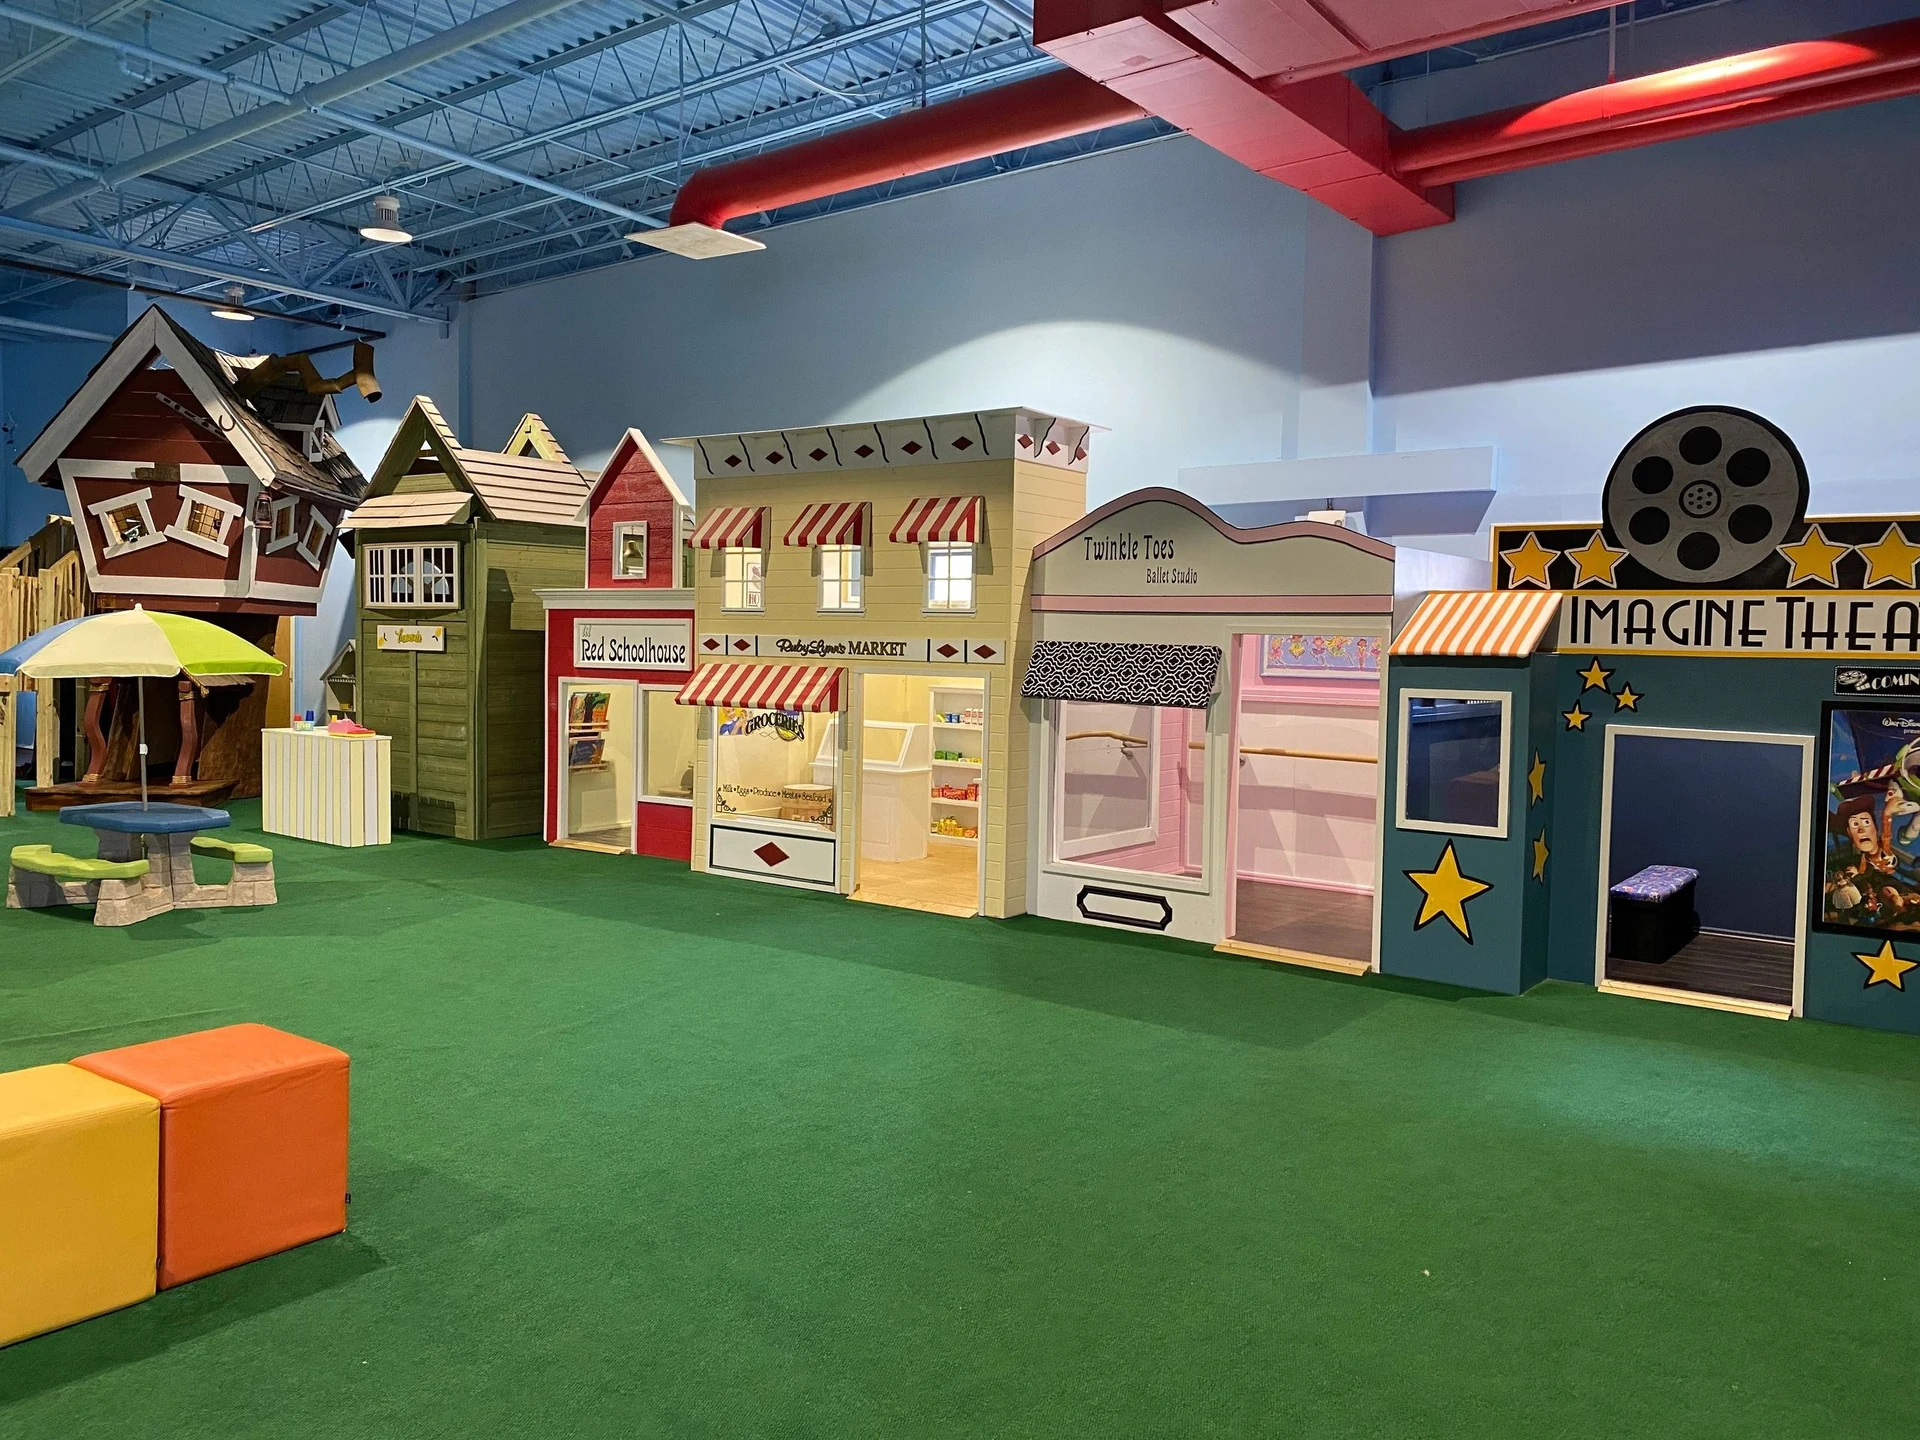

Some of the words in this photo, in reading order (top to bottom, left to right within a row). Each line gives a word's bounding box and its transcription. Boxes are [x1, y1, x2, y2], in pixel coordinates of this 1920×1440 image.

[1084, 532, 1139, 561] Twinkle
[1143, 535, 1175, 560] Toes
[1146, 566, 1169, 584] Ballet
[1171, 567, 1198, 584] Studio
[748, 593, 761, 605] HO
[1570, 595, 1767, 647] IMAGINE
[1776, 597, 1920, 652] THEA
[581, 636, 605, 661] Red
[608, 636, 686, 663] Schoolhouse
[848, 641, 907, 656] MARKET
[1871, 673, 1920, 690] COMIN
[745, 712, 805, 740] GROCERIES
[722, 783, 733, 793] Milk
[736, 785, 750, 798] Eggs
[753, 786, 777, 798] Produce
[781, 789, 798, 800] Meats
[801, 791, 827, 803] Seafood
